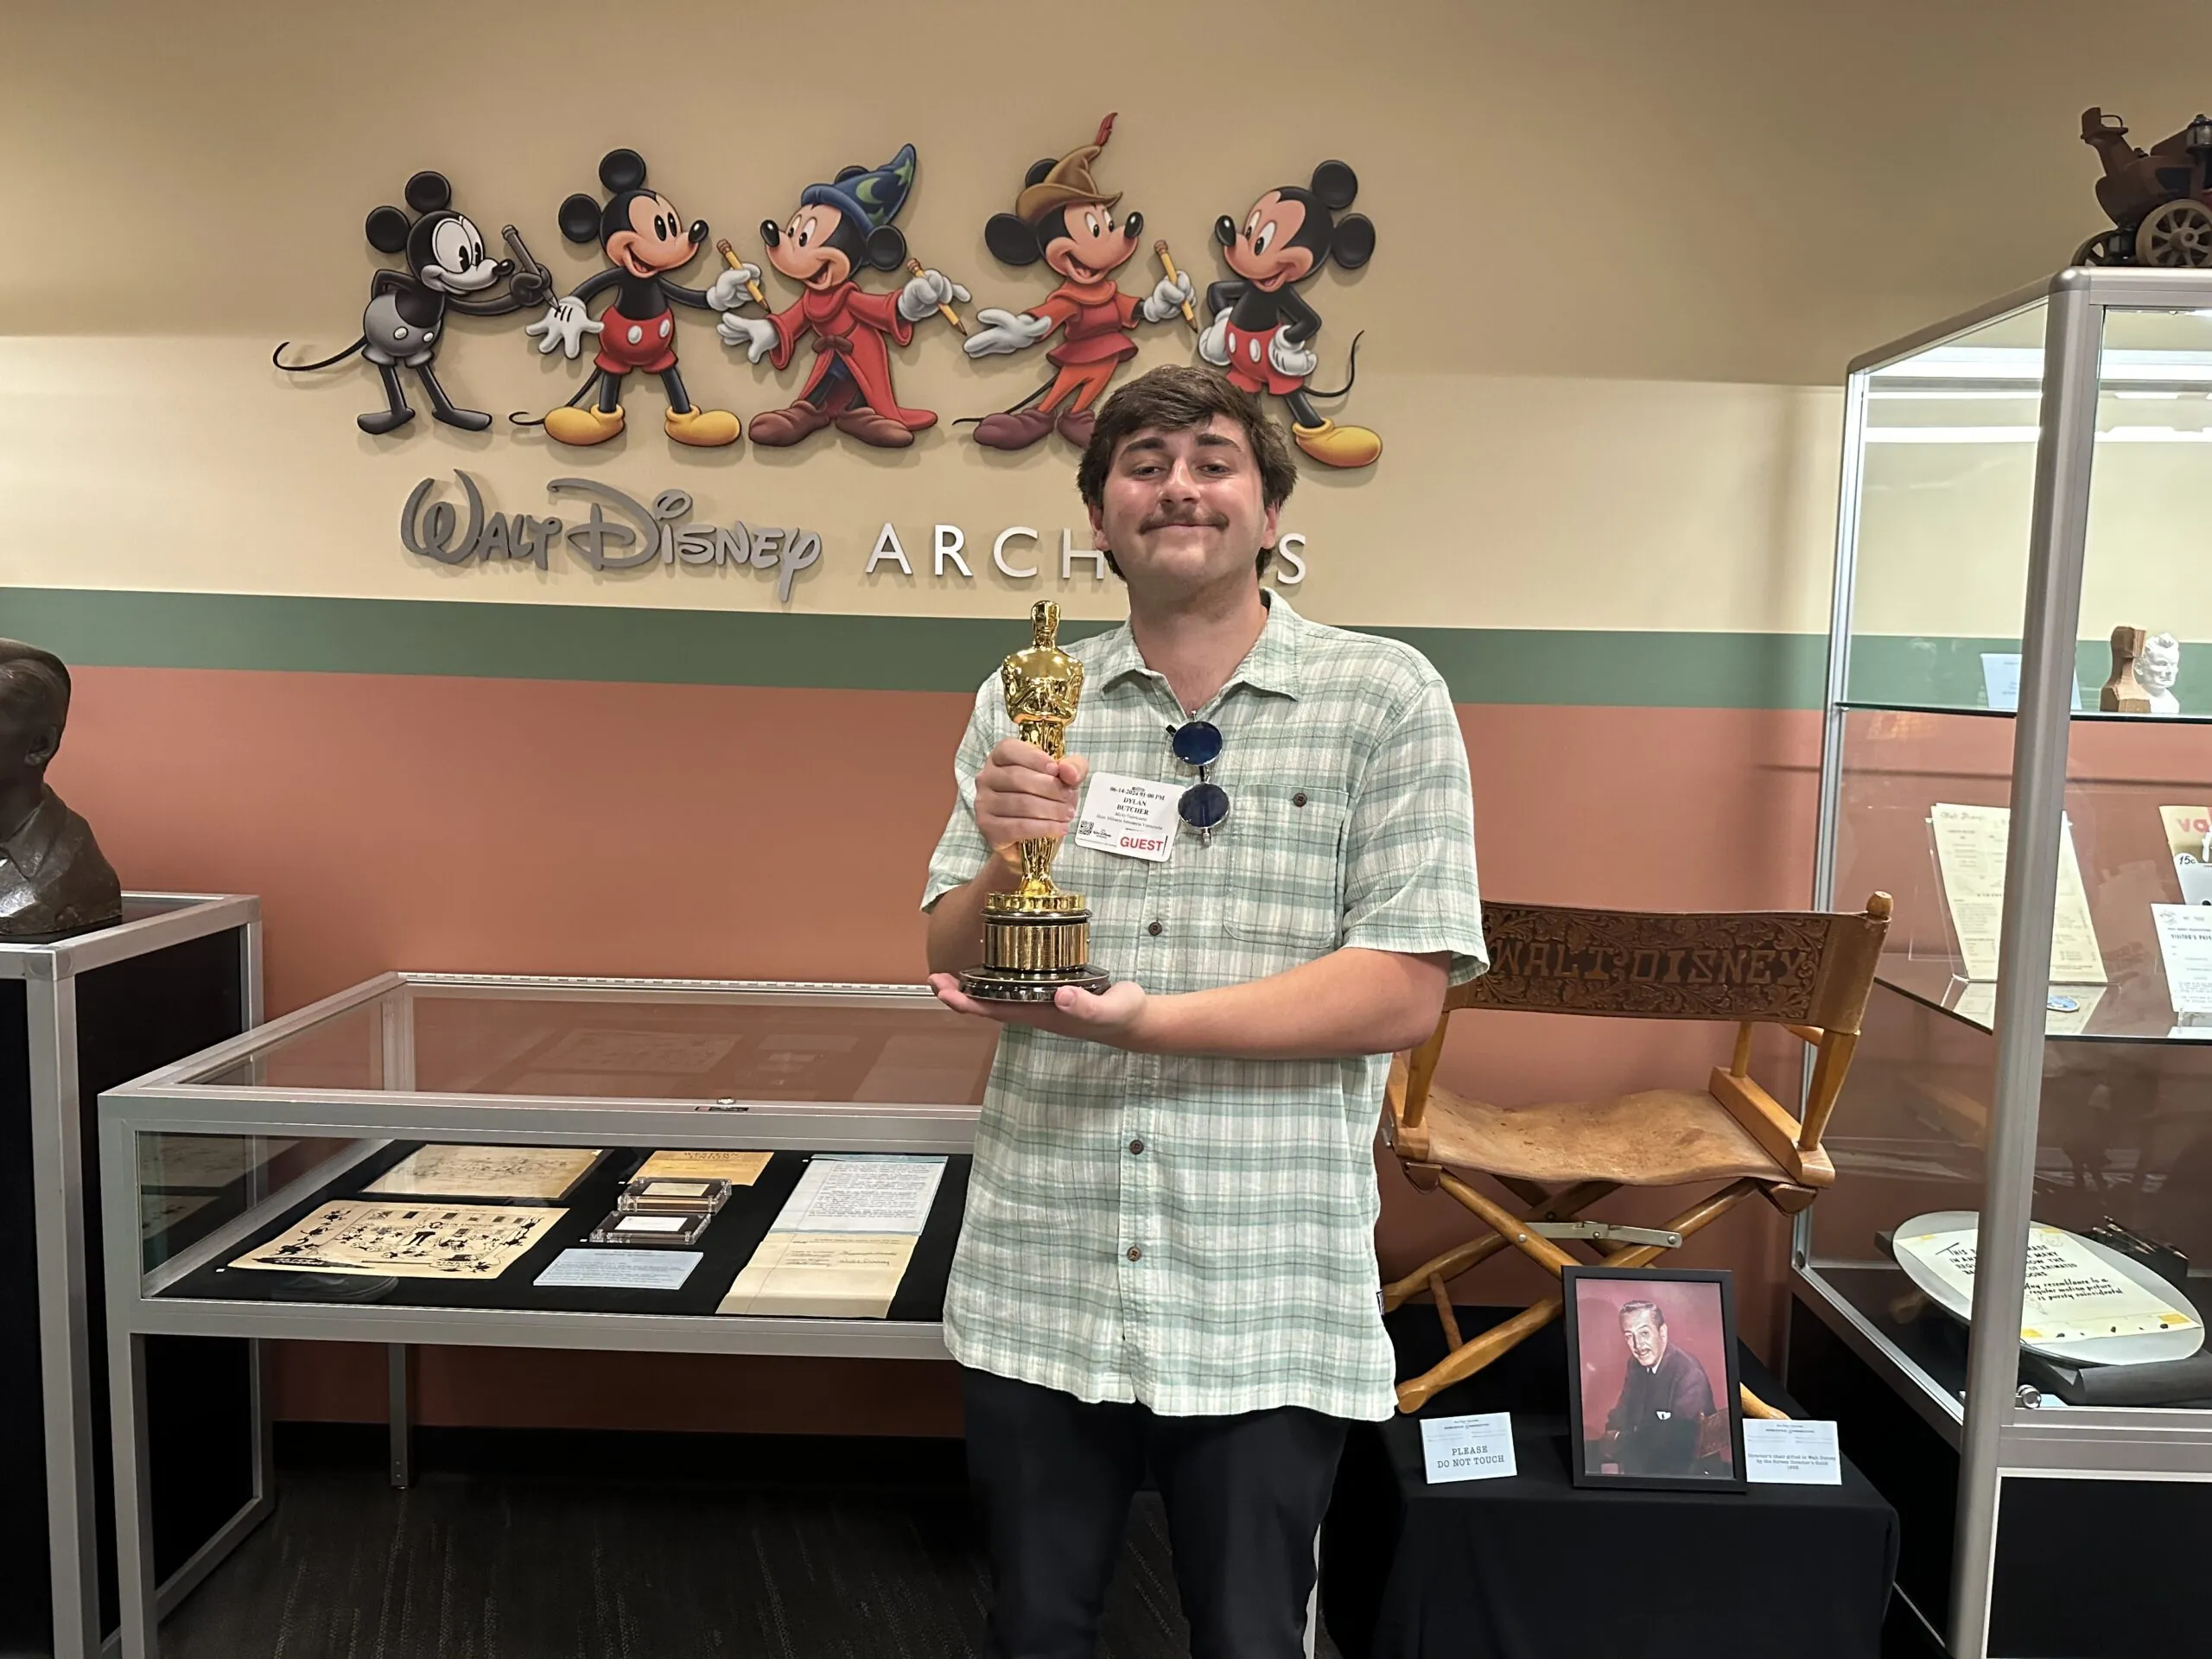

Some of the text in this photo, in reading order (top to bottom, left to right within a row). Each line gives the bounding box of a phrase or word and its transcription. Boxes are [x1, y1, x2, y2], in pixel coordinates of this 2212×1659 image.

[866, 523, 1306, 583] ARCHS
[1123, 797, 1147, 806] DYLAN
[1116, 804, 1149, 815] BUTCHER
[1120, 836, 1164, 851] GUEST
[1491, 939, 1806, 986] WALT DISNEY
[2044, 1278, 2089, 1287] resemblance
[2075, 1287, 2124, 1297] coincidental
[1452, 1446, 1488, 1456] PLEASE
[1437, 1454, 1505, 1468] DO NOT TOUCH
